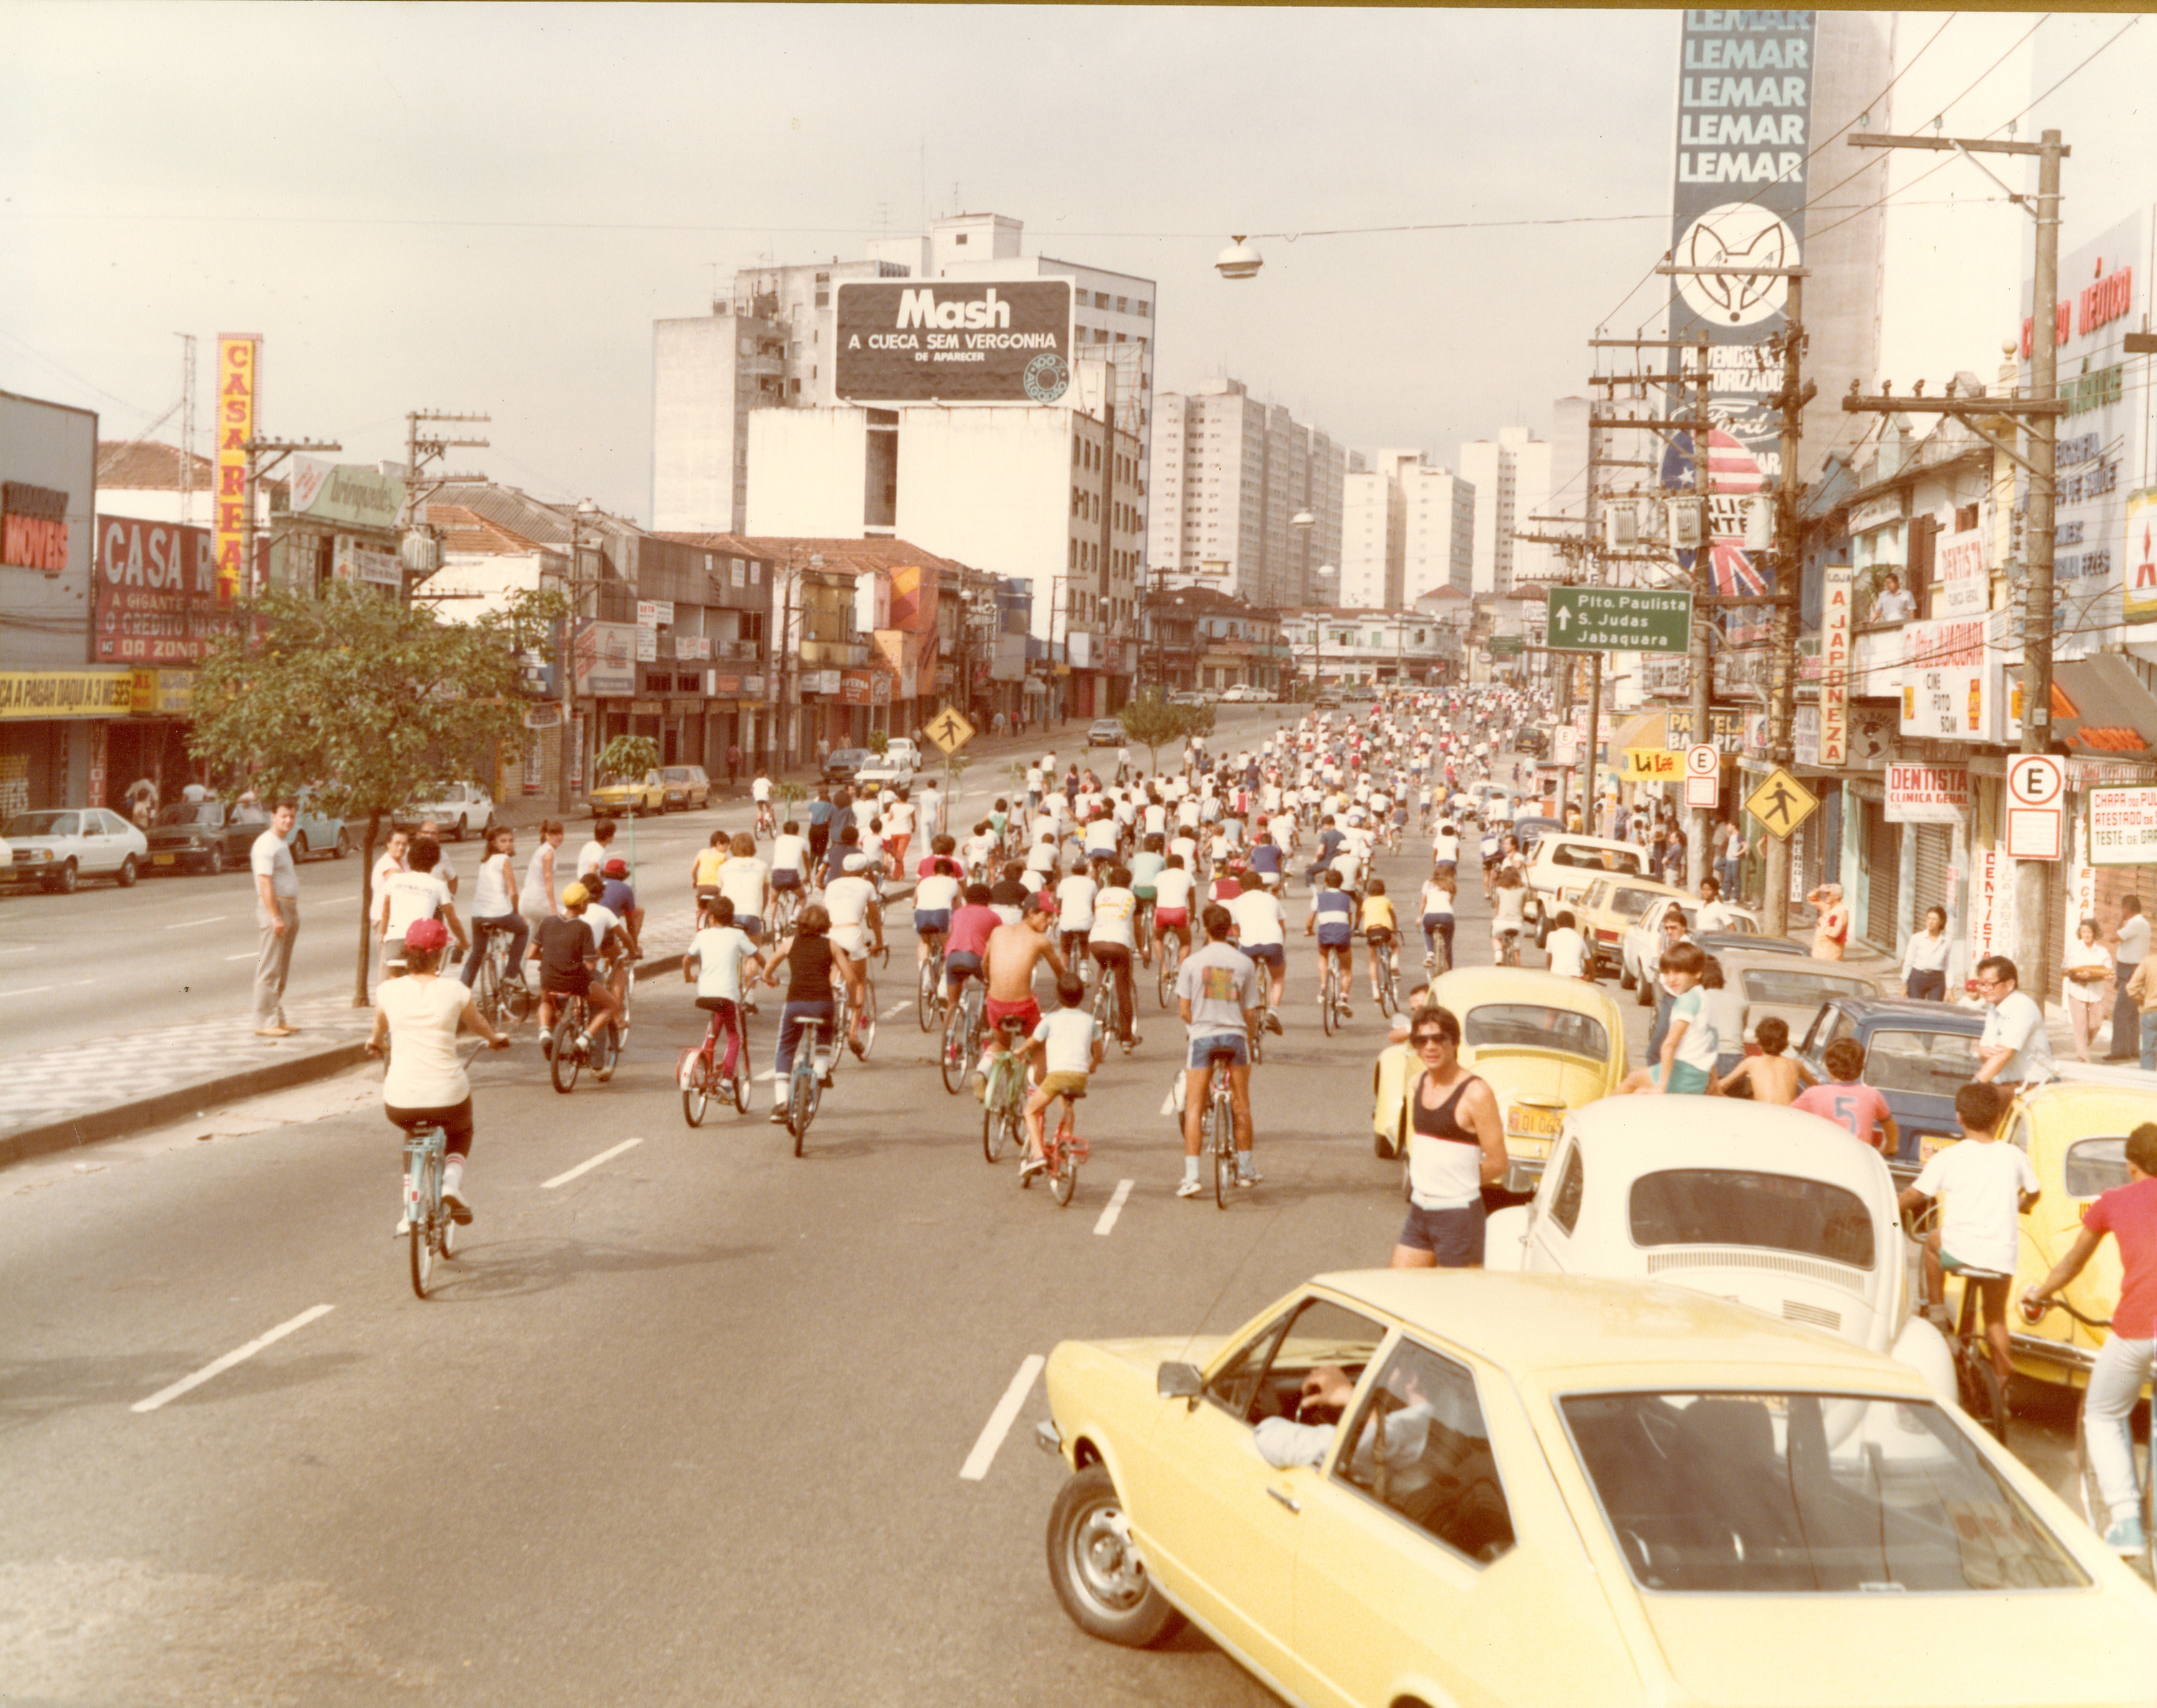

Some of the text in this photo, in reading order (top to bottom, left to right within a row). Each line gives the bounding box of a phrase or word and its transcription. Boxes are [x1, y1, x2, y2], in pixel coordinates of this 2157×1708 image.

[1686, 9, 1810, 31] LEMAR
[1685, 39, 1809, 69] LEMAR
[1683, 77, 1806, 107] LEMAR
[1681, 115, 1805, 145] LEMAR
[1679, 152, 1803, 182] LEMAR
[896, 288, 1010, 329] Mash
[848, 333, 1057, 349] A CUECA SEM VERGONHA
[915, 352, 985, 362] DE APARECER
[223, 345, 249, 450] CASA
[105, 521, 183, 591] CASA
[126, 594, 185, 612] GIGANTE
[1618, 596, 1686, 611] Paulista
[1578, 612, 1649, 627] S. Judas
[121, 639, 145, 657] DA
[153, 640, 198, 657] ZONA
[1577, 630, 1669, 647] Jabaquara
[1826, 614, 1845, 761] JAPONEZA
[1933, 693, 1951, 712] FOTO
[1941, 715, 1957, 733] SOM
[1634, 753, 1652, 773] Li
[1697, 753, 1707, 768] E
[1891, 768, 1969, 791] DENTISTA
[2027, 768, 2044, 794] E
[1890, 792, 1969, 804] CLINICA GERAL
[2095, 793, 2126, 808] CHAPA
[2095, 811, 2141, 826] ATESTADO
[2095, 830, 2123, 845] TESTE
[2127, 834, 2138, 845] DE
[1834, 1096, 1857, 1135] 5
